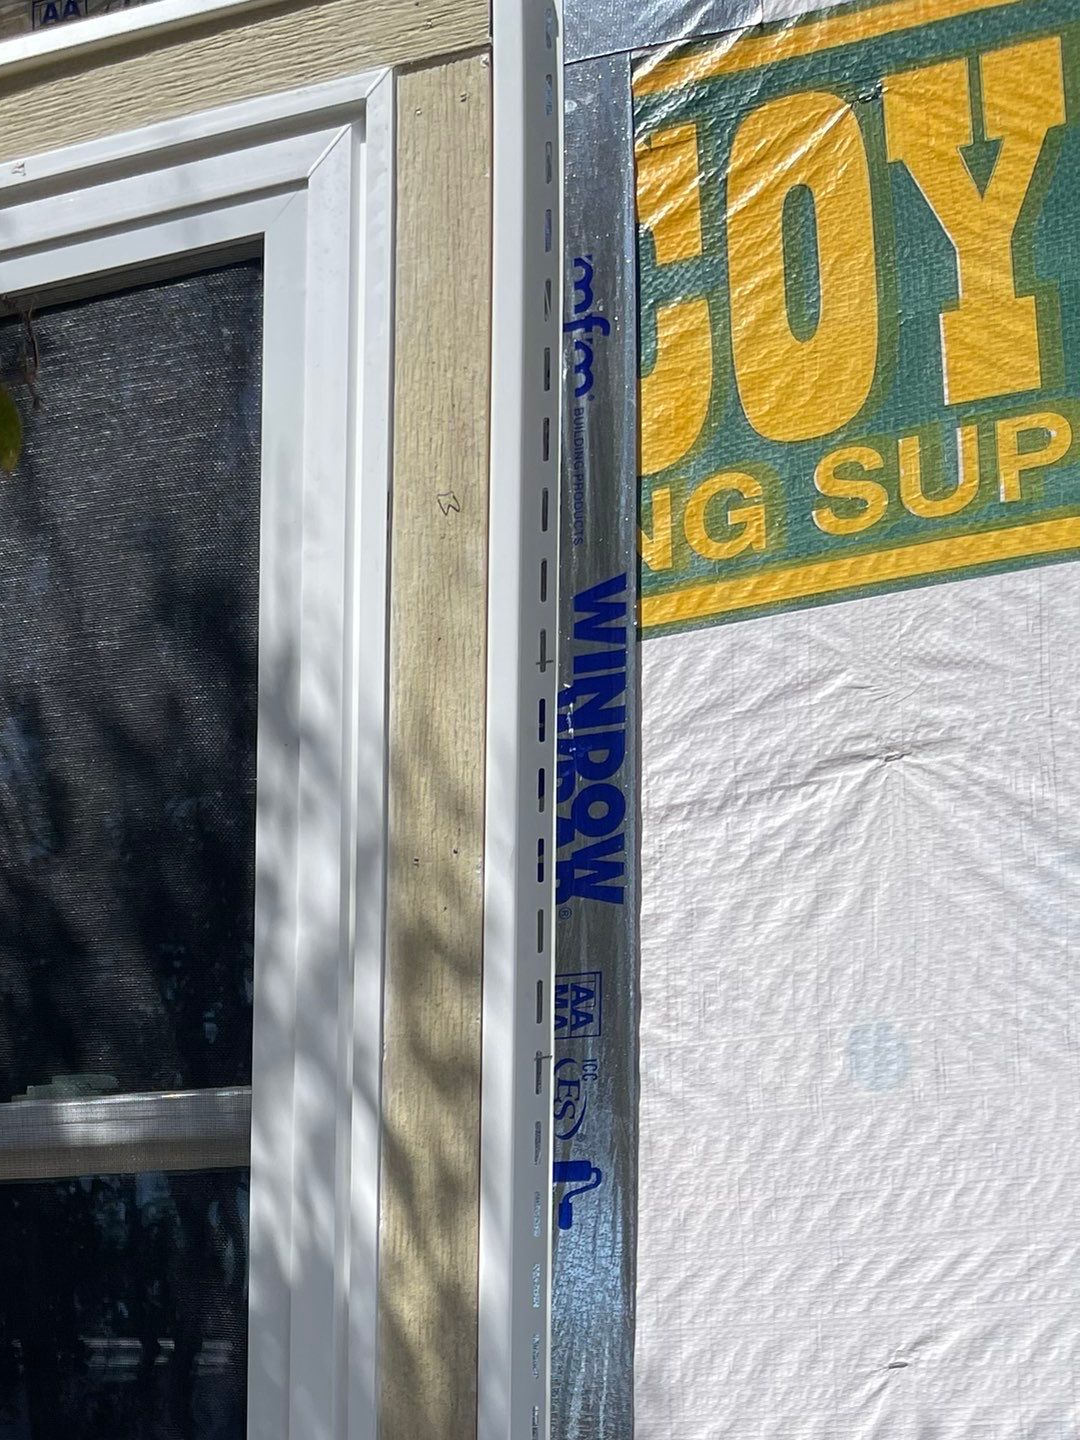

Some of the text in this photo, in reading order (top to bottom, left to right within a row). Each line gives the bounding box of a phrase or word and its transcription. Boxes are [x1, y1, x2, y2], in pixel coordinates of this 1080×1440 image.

[573, 407, 584, 546] BUILDING PRODUCTS
[812, 411, 1072, 536] SUP
[572, 572, 627, 905] WINDOW
